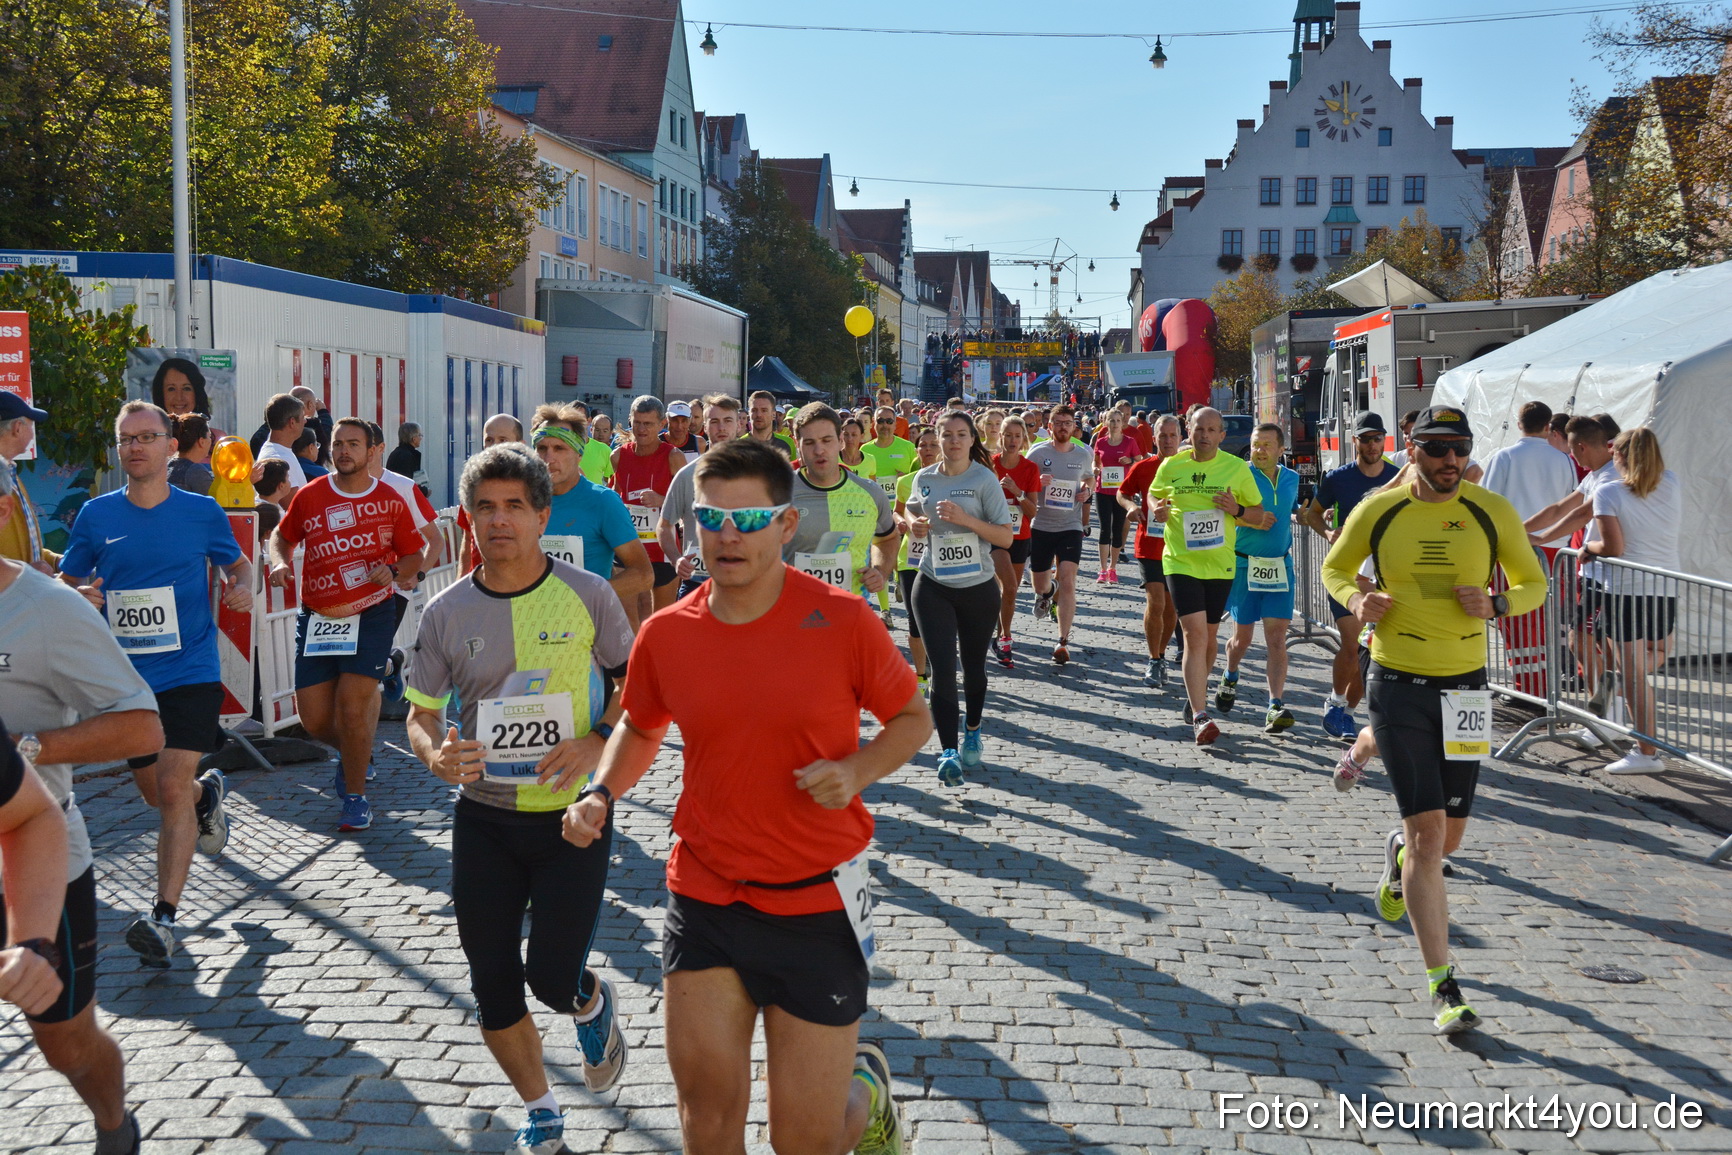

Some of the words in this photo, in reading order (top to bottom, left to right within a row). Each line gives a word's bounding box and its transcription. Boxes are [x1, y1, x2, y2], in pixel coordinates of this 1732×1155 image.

[995, 345, 1030, 354] START
[8, 372, 20, 382] für
[1050, 487, 1072, 498] 2379
[327, 504, 351, 514] raumbox
[1191, 520, 1219, 534] 2297
[353, 548, 377, 558] outdoor
[939, 545, 972, 561] 3050
[341, 562, 364, 572] raumbox
[1253, 567, 1279, 579] 2601
[122, 594, 152, 603] BOCK
[117, 606, 165, 627] 2600
[314, 622, 351, 636] 2222
[130, 638, 156, 647] Stefan
[318, 643, 343, 651] Andreas
[504, 704, 545, 715] BOCK
[1457, 710, 1485, 731] 205
[492, 720, 561, 750] 2228
